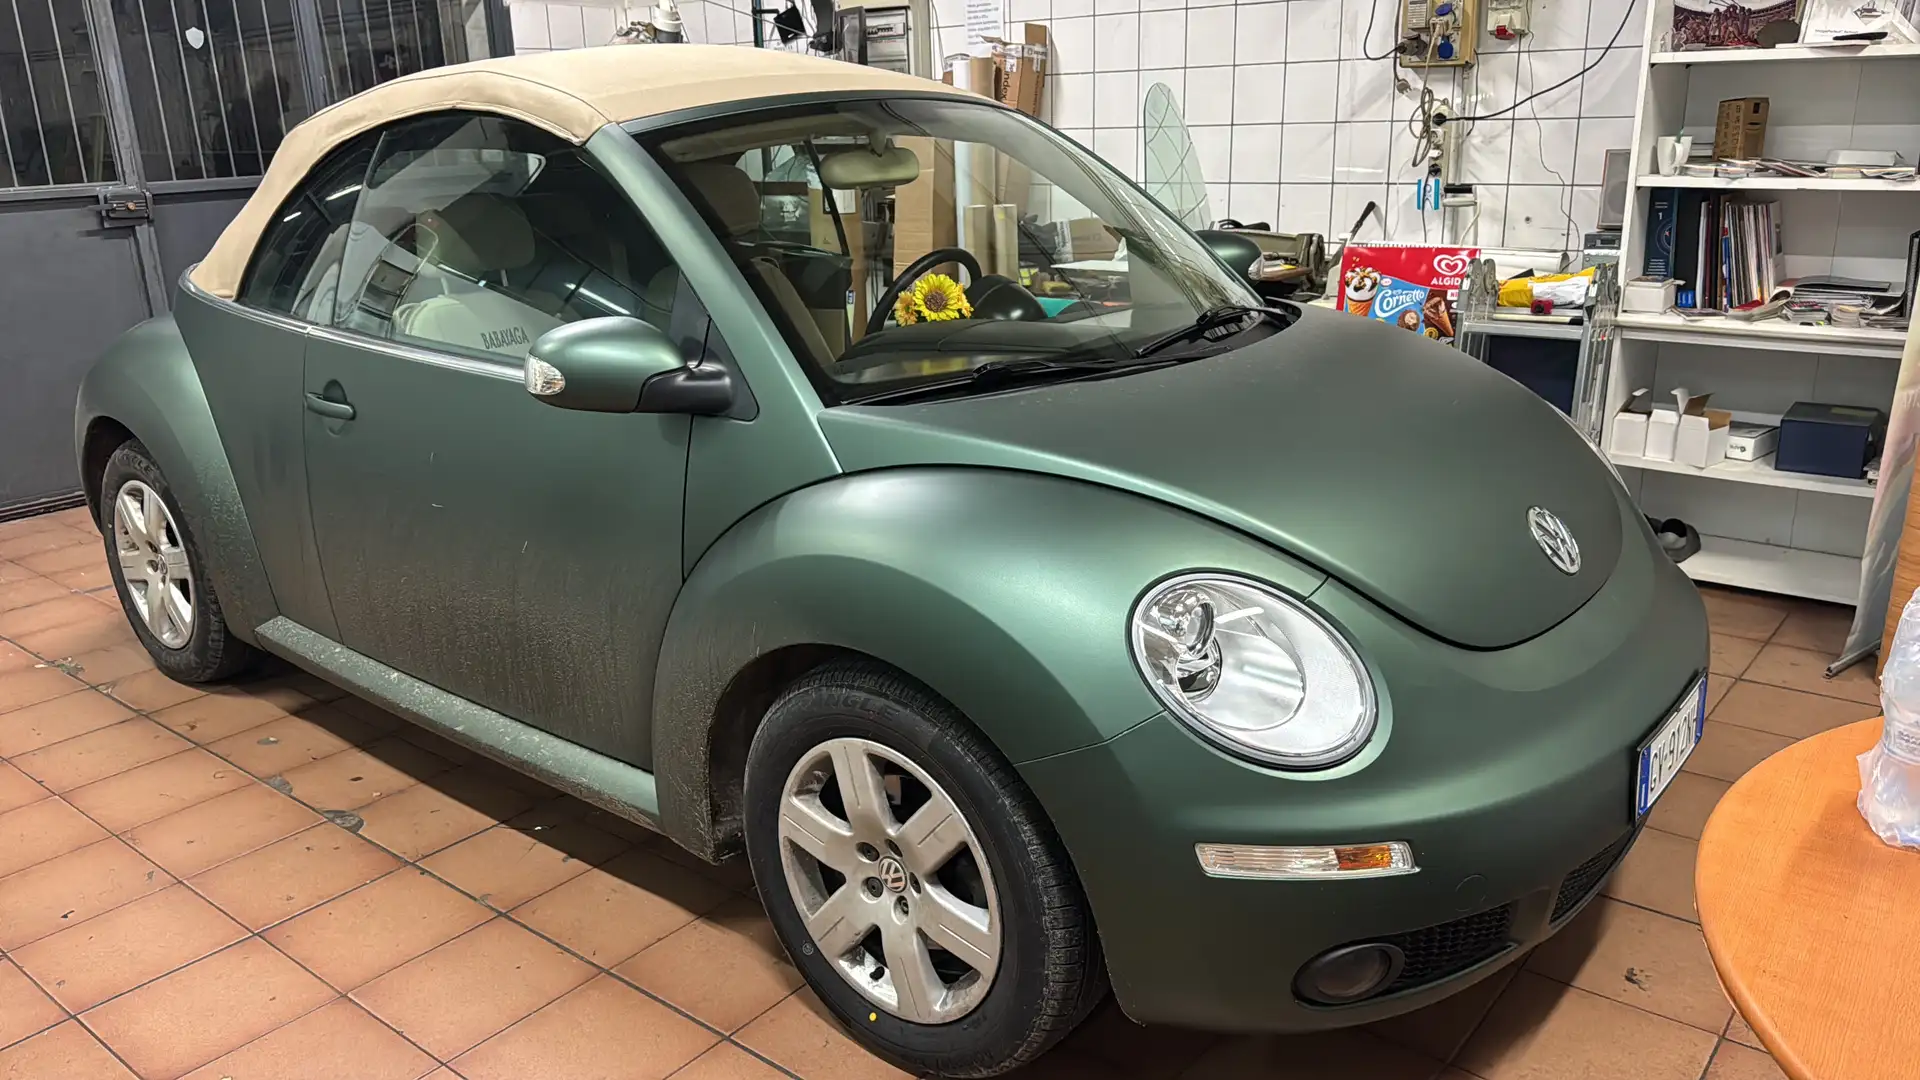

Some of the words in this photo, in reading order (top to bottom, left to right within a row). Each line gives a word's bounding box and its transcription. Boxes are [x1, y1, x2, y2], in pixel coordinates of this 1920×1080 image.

[1431, 277, 1461, 286] ALGID
[1374, 289, 1425, 318] Cornetto
[481, 327, 530, 349] BABAYAGA
